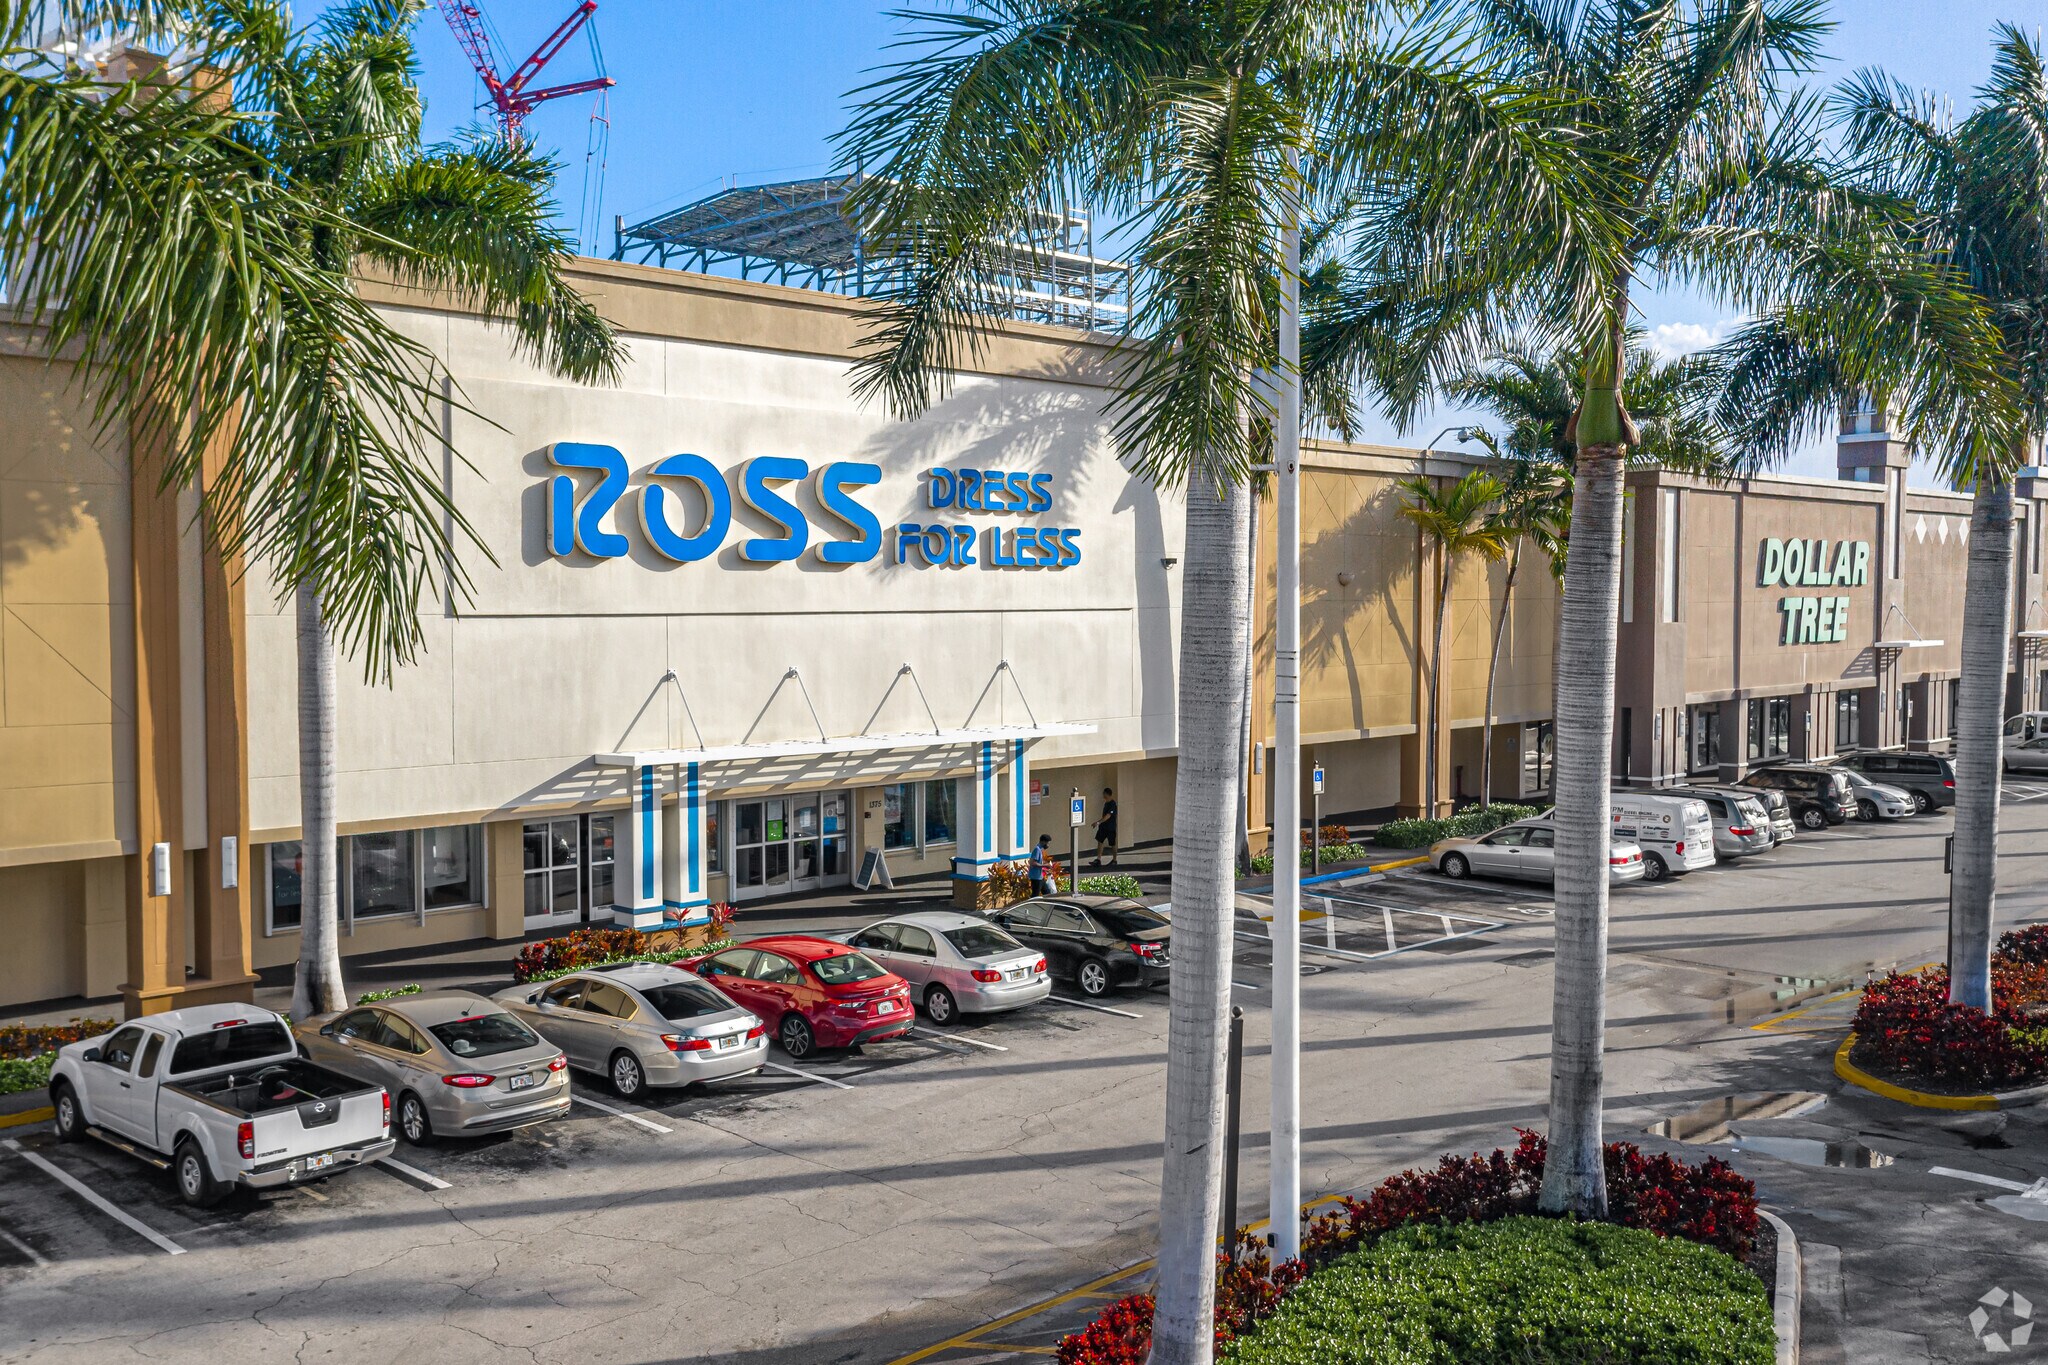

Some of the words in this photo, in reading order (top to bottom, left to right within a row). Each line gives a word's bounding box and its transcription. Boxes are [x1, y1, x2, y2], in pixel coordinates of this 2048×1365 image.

[546, 441, 883, 562] ROSS
[928, 467, 1053, 512] DRESS
[894, 523, 977, 565] FOR
[990, 526, 1081, 567] LESS
[1761, 537, 1870, 586] DOLLAR
[1782, 596, 1850, 644] TREE
[869, 800, 882, 809] 1375
